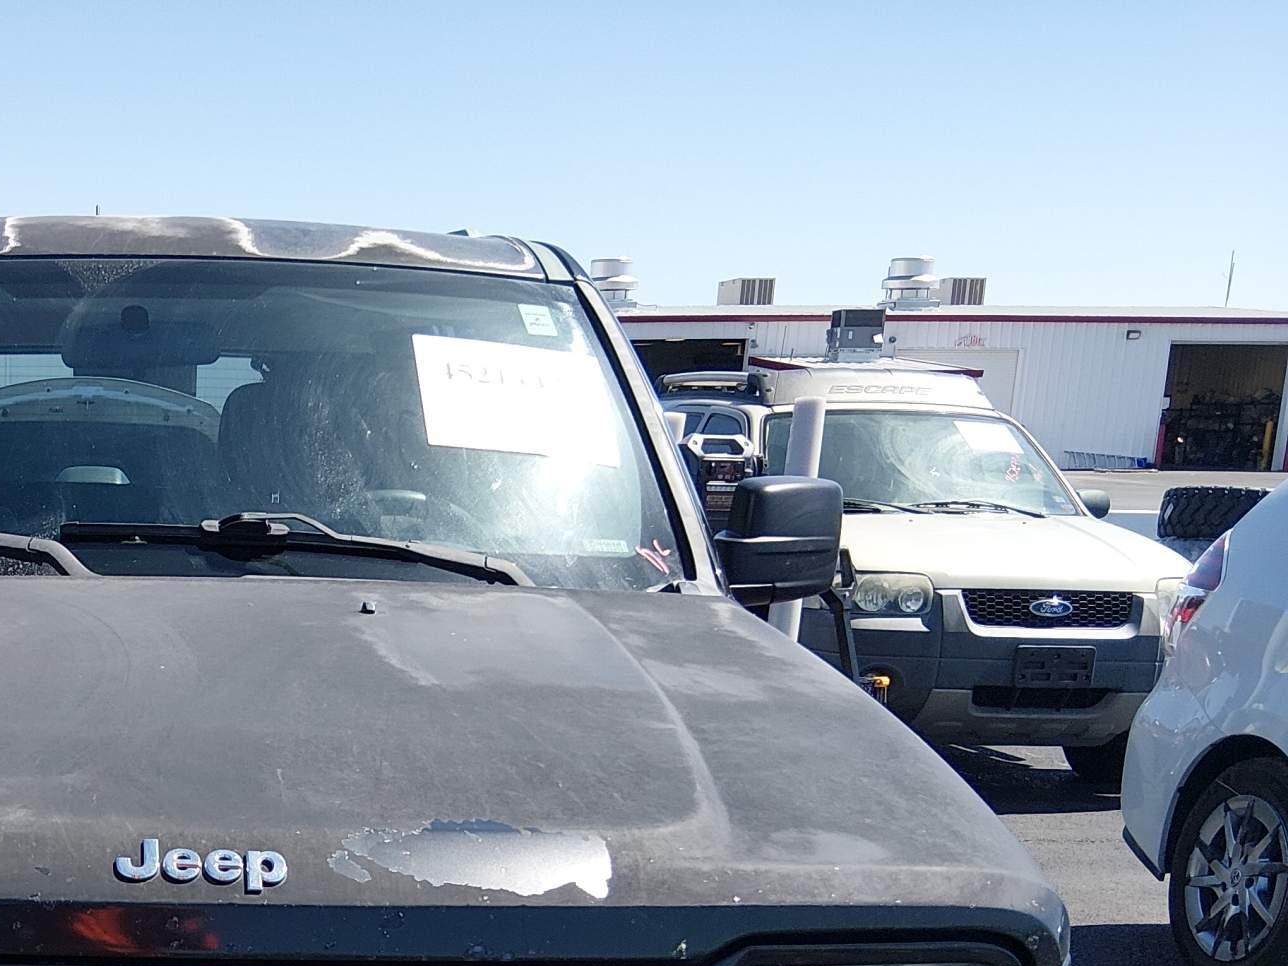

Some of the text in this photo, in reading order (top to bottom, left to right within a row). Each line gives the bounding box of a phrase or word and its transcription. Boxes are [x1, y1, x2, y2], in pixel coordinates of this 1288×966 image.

[827, 384, 933, 396] ESCAPE
[1040, 602, 1064, 613] Ford
[113, 837, 289, 894] Jeep
